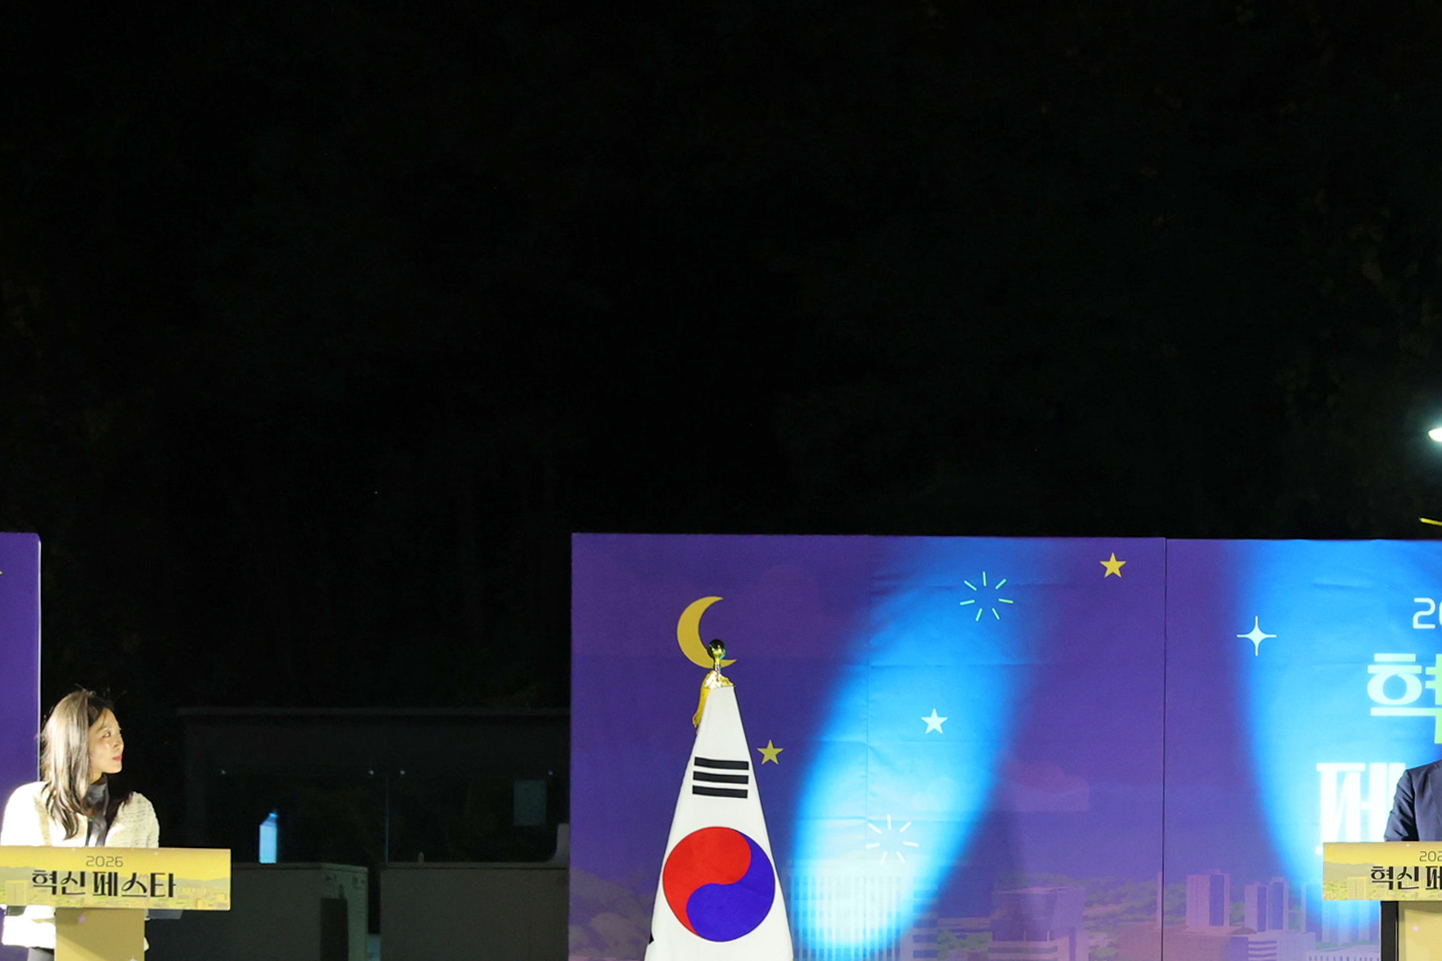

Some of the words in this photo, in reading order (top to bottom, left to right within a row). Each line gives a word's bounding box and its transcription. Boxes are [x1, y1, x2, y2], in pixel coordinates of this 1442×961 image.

[85, 855, 124, 868] 2026
[32, 869, 86, 896] 혁신
[92, 871, 177, 898] 페스타
[1371, 865, 1420, 890] 혁신
